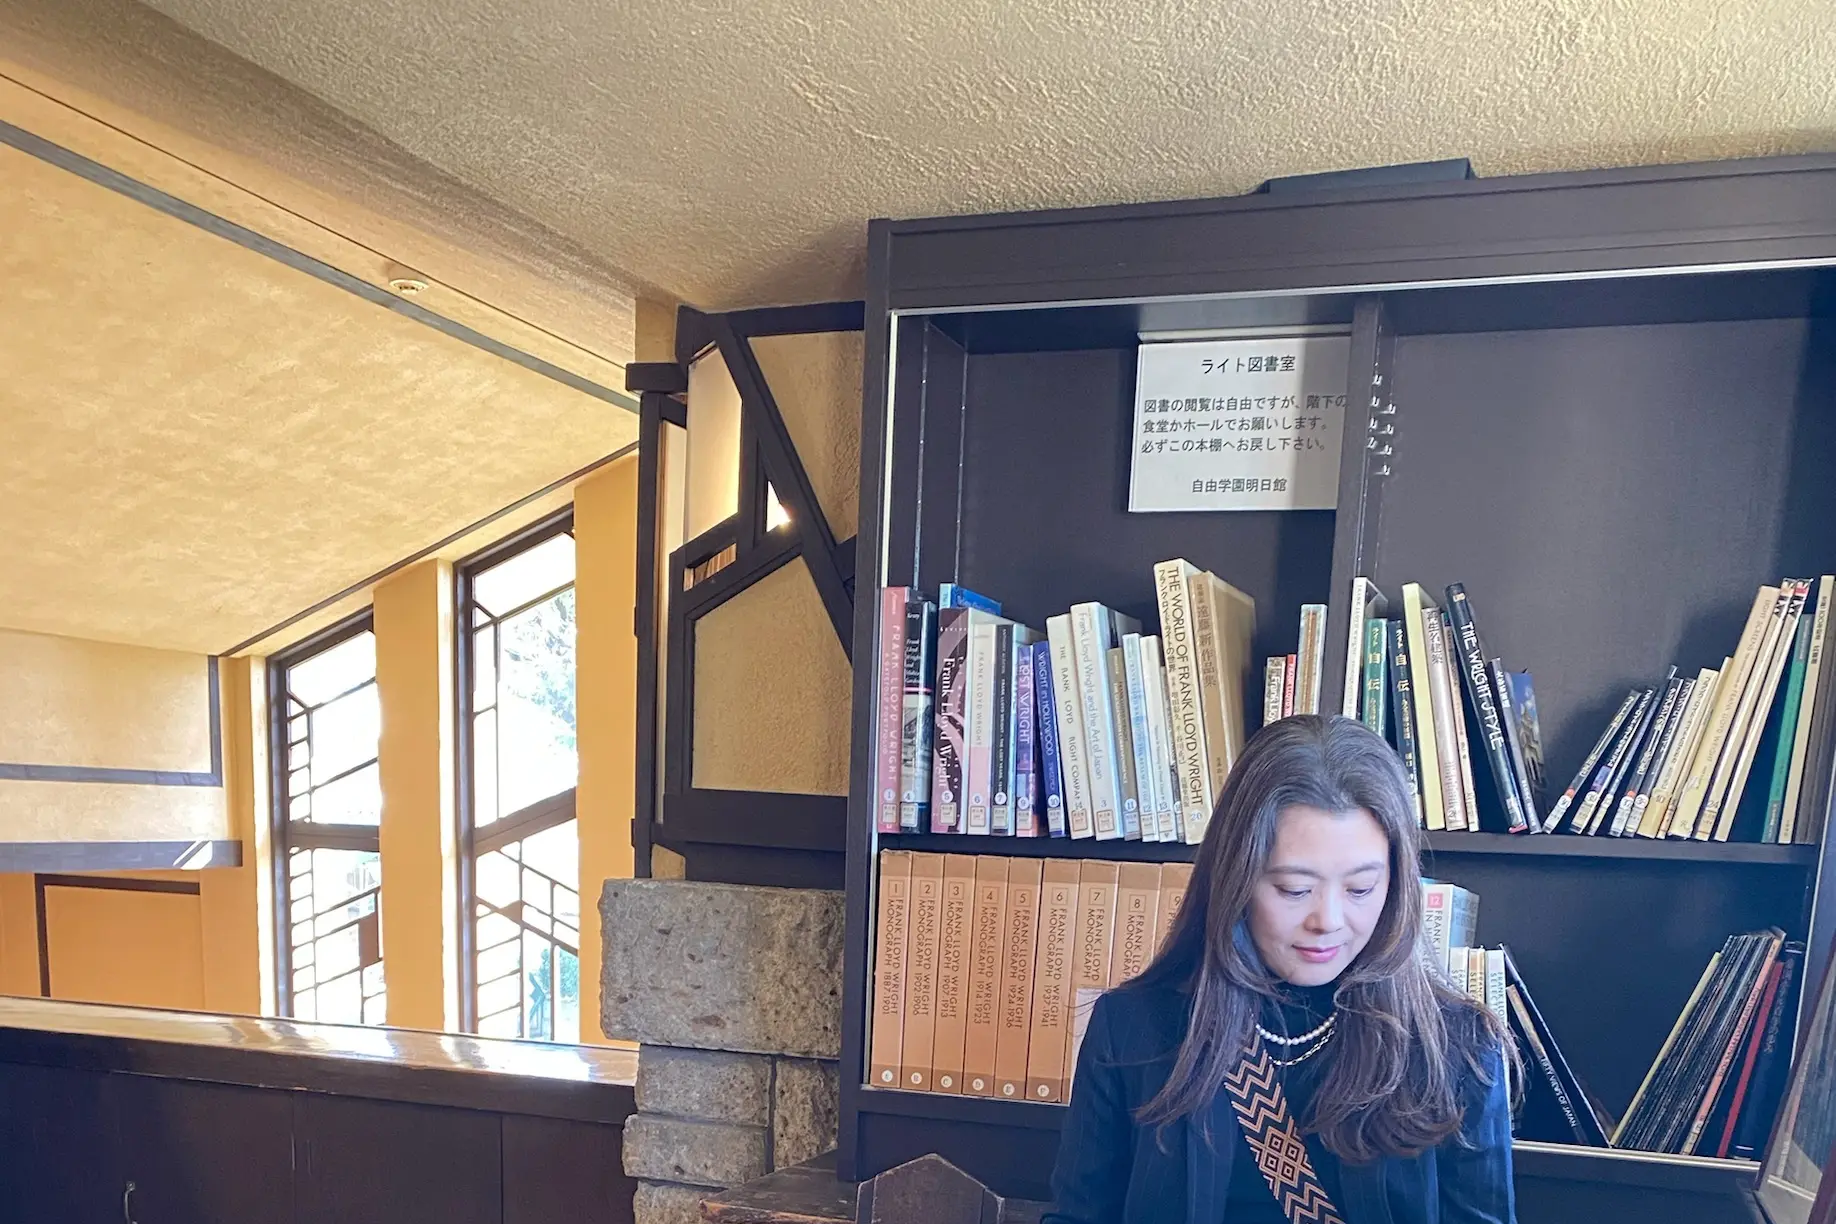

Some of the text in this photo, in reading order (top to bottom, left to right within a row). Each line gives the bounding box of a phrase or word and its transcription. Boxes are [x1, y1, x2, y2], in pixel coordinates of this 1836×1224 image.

[1200, 355, 1296, 374] ライト図書室
[1143, 416, 1328, 434] 食堂かホールでお願いします。
[1144, 395, 1347, 413] 図書の閲覧は自由ですが、階下の
[1141, 437, 1326, 454] 必ずこの本棚へお戻し下さい。
[1192, 478, 1288, 493] 自由学園明日館
[891, 624, 900, 670] FRANK
[1037, 651, 1048, 688] WRIGHT
[890, 677, 899, 721] LLOYD
[1078, 612, 1104, 780] Frank Lloyd Wright and the Art of Japan
[1168, 566, 1204, 804] THE WORLD OF FRANK LLOYD WRIGHT
[1270, 676, 1281, 701] Frank
[1460, 621, 1505, 751] THE WRIGHT STYLE
[937, 657, 955, 789] Frank Lloyd Wright
[1019, 693, 1030, 744] WRIGHT
[1042, 700, 1054, 755] HOLLYWOOD
[888, 729, 898, 782] WRIGHT
[925, 884, 931, 894] 2
[953, 886, 960, 896] 3
[986, 891, 993, 900] 4
[1020, 893, 1027, 903] 5
[1056, 892, 1063, 901] 6
[1094, 891, 1101, 901] 7
[1134, 899, 1141, 908] 8
[1174, 896, 1182, 905] 9
[1426, 910, 1434, 921] IN
[884, 898, 895, 966] MONOGRAPH
[915, 899, 926, 967] MONOGRAPH
[943, 901, 954, 969] MONOGRAPH
[977, 907, 988, 975] MONOGRAPH
[1009, 909, 1021, 978] MONOGRAPH
[1045, 908, 1057, 977] MONOGRAPH
[1083, 909, 1095, 978] MONOGRAPH
[1091, 909, 1105, 981] FRANK LLOYD
[1132, 915, 1145, 974] FRANK LLO
[1433, 910, 1443, 943] FRANK
[890, 899, 903, 1015] FRANK LLOYD WRIGHT
[921, 899, 935, 1016] FRANK LLOYD WRIGHT
[949, 901, 964, 1019] FRANK LLOYD WRIGHT
[982, 907, 997, 1025] FRANK LLOYD WRIGHT
[1014, 909, 1030, 1029] FRANK LLOYD WRIGHT
[1050, 908, 1067, 1028] FRANK LLOYD WRIGHT
[1541, 1057, 1576, 1128] FIFTY VIEWS OF JAPAN
